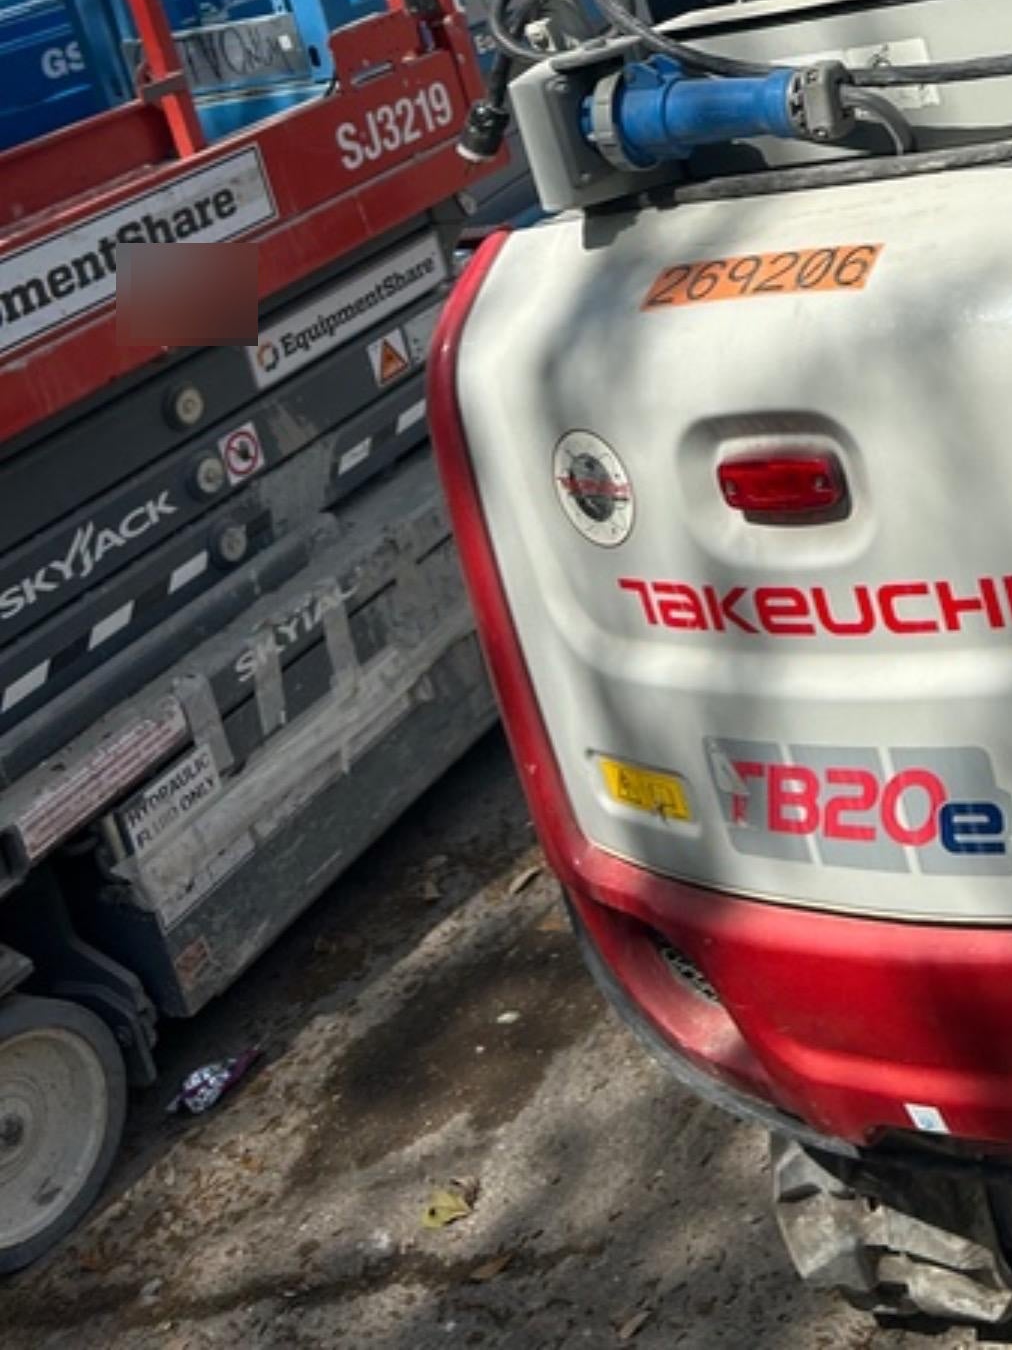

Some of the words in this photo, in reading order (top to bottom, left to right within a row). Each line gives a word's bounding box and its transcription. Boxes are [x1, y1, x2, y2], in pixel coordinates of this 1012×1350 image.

[335, 81, 454, 170] SJ3219
[279, 257, 436, 358] EquipmentShare
[646, 245, 877, 307] 269206
[0, 489, 178, 620] SKYJACK
[126, 752, 211, 828] HYDRAULIC
[178, 776, 214, 811] ONLY
